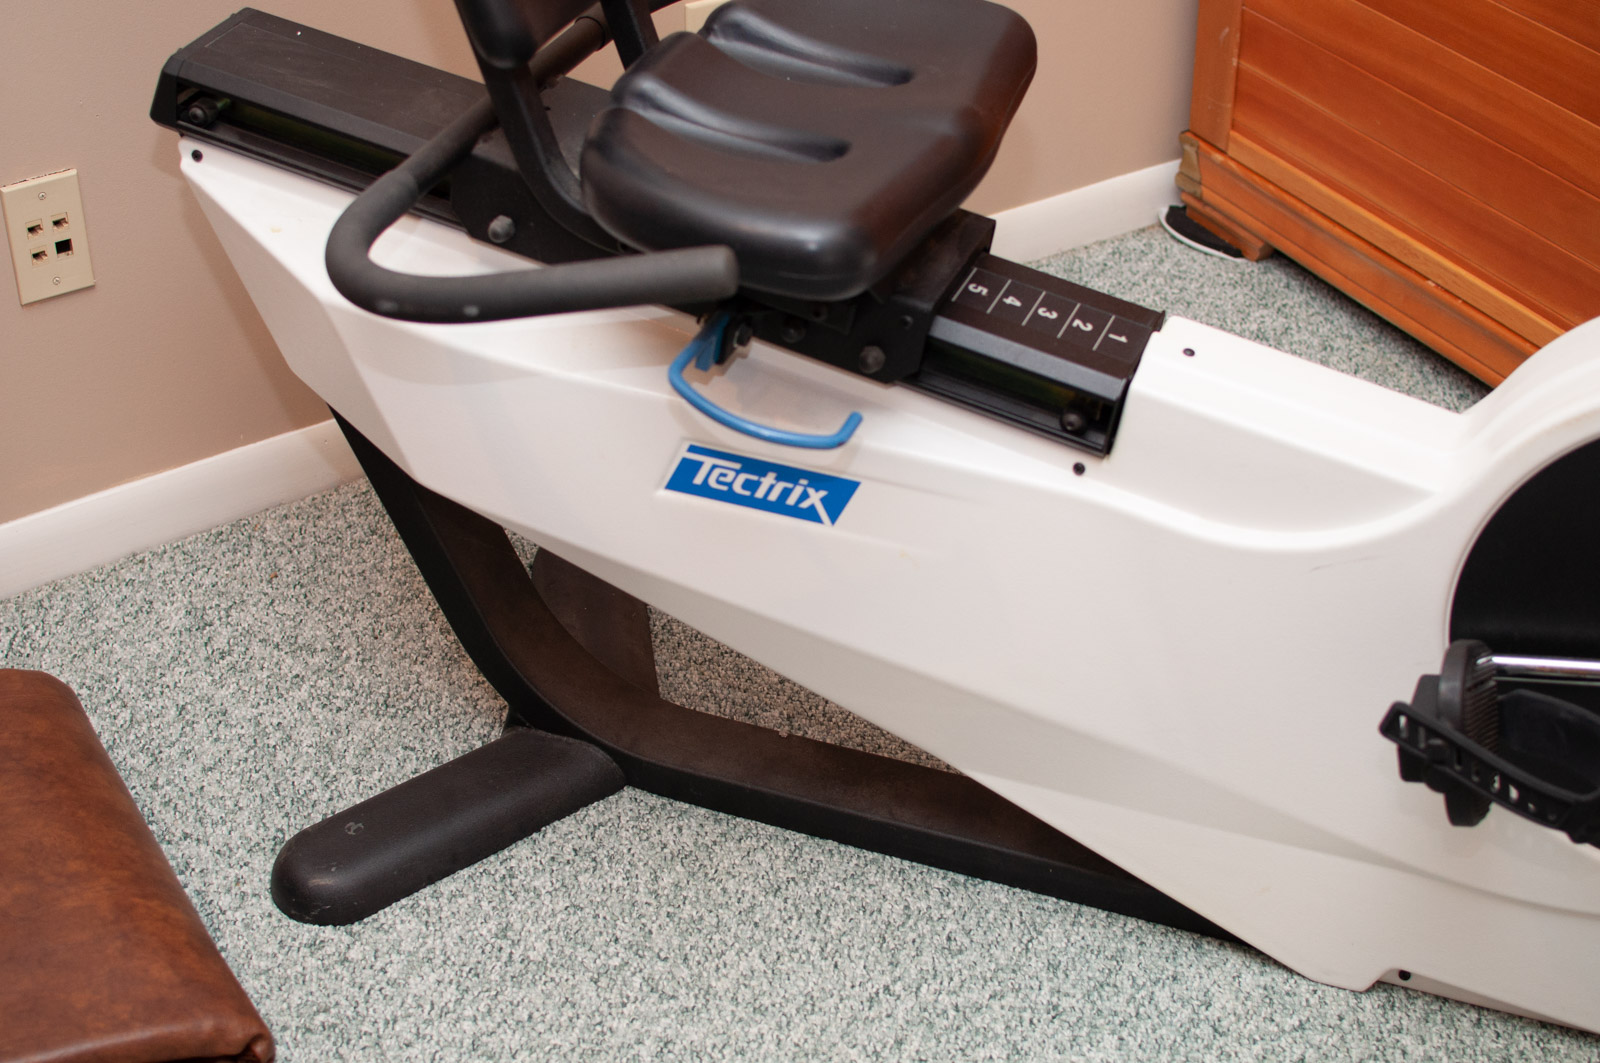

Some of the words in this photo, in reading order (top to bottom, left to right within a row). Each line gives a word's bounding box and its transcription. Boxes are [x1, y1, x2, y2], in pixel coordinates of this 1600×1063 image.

[968, 283, 989, 296] 5
[1002, 295, 1022, 308] 4
[1037, 307, 1058, 320] 3
[1072, 319, 1093, 332] 2
[1108, 333, 1128, 343] 1
[685, 451, 834, 526] Tectrix
